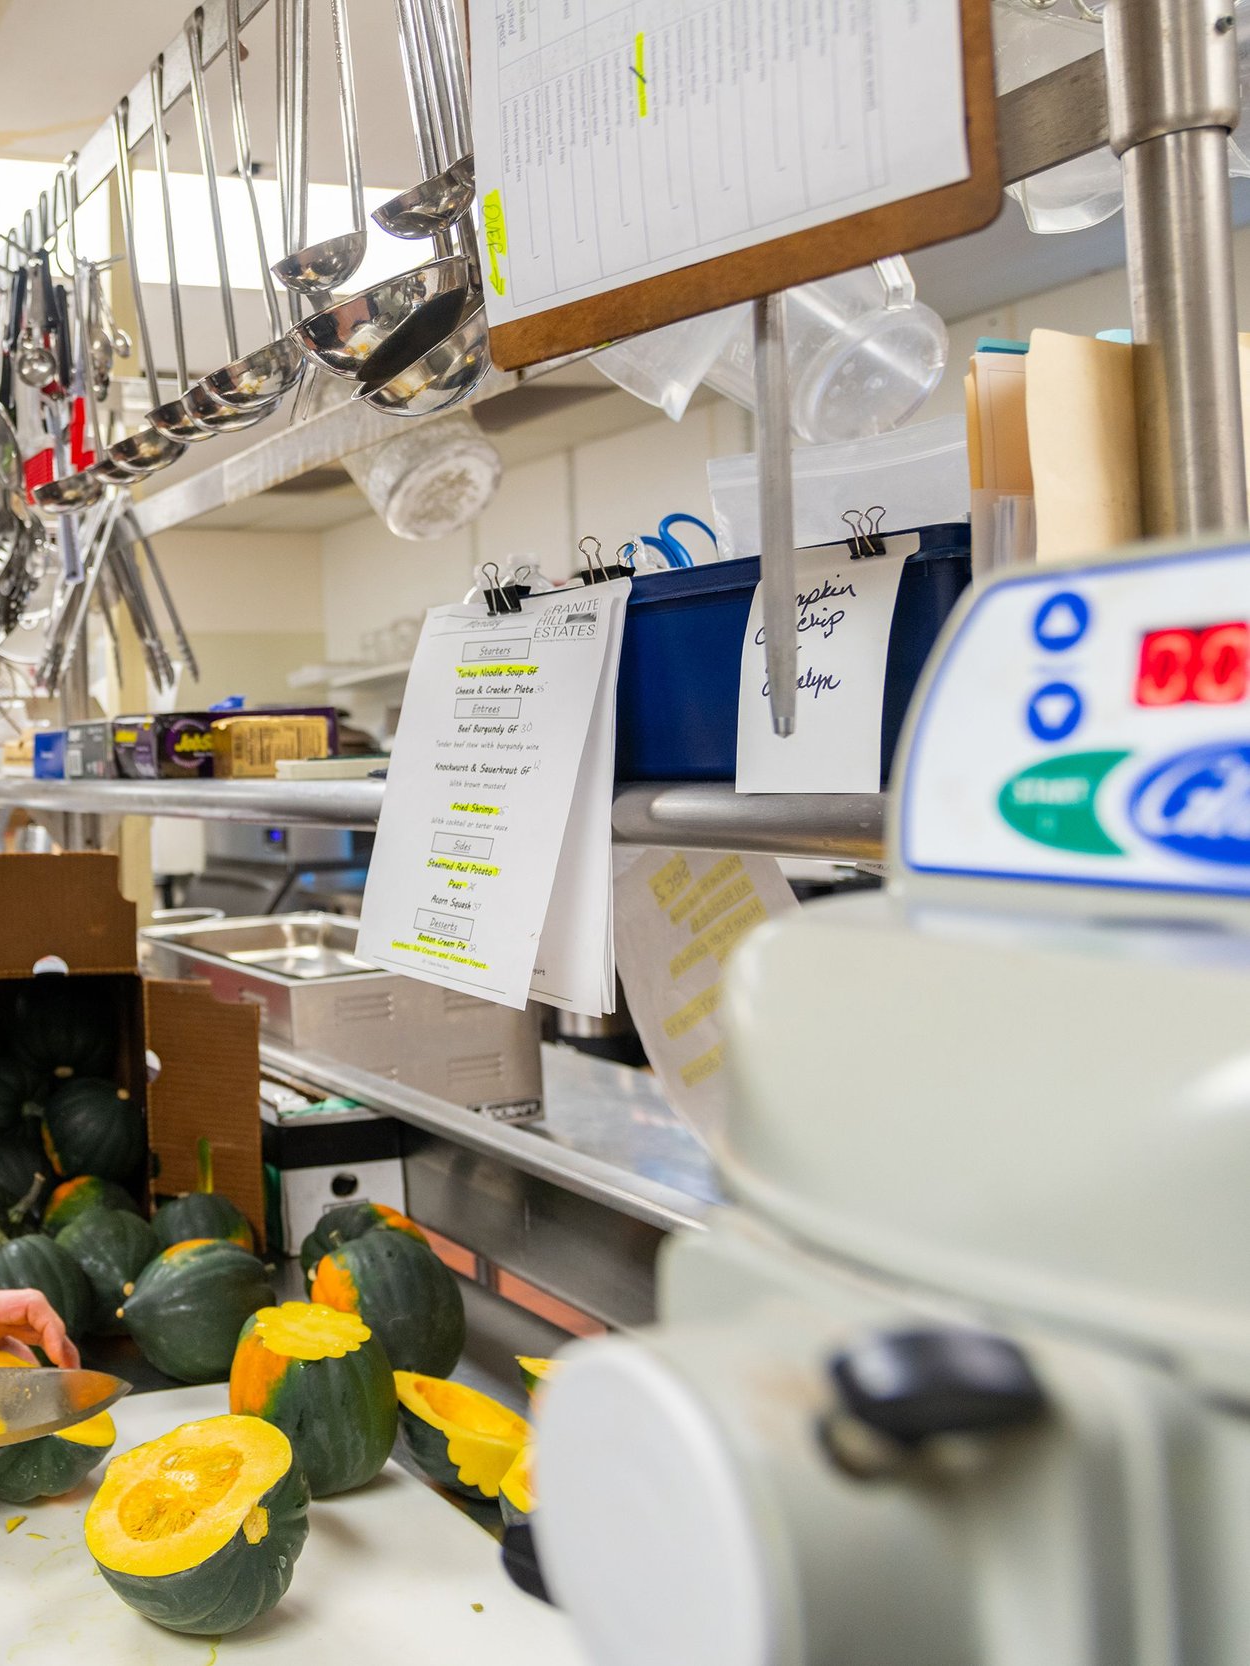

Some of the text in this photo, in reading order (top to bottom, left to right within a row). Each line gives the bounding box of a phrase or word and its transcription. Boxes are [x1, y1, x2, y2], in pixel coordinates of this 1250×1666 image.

[481, 204, 504, 254] OVER
[537, 615, 564, 626] HILL
[533, 624, 596, 639] ESTATES
[479, 645, 511, 657] Starters
[458, 666, 539, 679] Turkey Noodle Soup GF
[455, 684, 534, 695] Cheese & Cracker Plate
[472, 703, 501, 714] Entrees
[457, 724, 519, 736] Beef Burgundy GF
[434, 762, 532, 775] Knockwurst & Sauerkraut GF
[464, 780, 481, 789] brown
[482, 781, 507, 790] mustard
[452, 802, 494, 816] Fried Shrimp
[445, 819, 465, 827] cocktail
[453, 840, 471, 851] Sides
[427, 858, 493, 877] Steamed Red Potato
[448, 878, 462, 890] Peas
[431, 894, 472, 911] Acorn Squash
[430, 917, 458, 932] Desserts
[417, 932, 467, 951] Boston Cream Pie
[449, 953, 467, 964] Frozen
[468, 958, 487, 969] Yogurt
[532, 968, 546, 976] gurt
